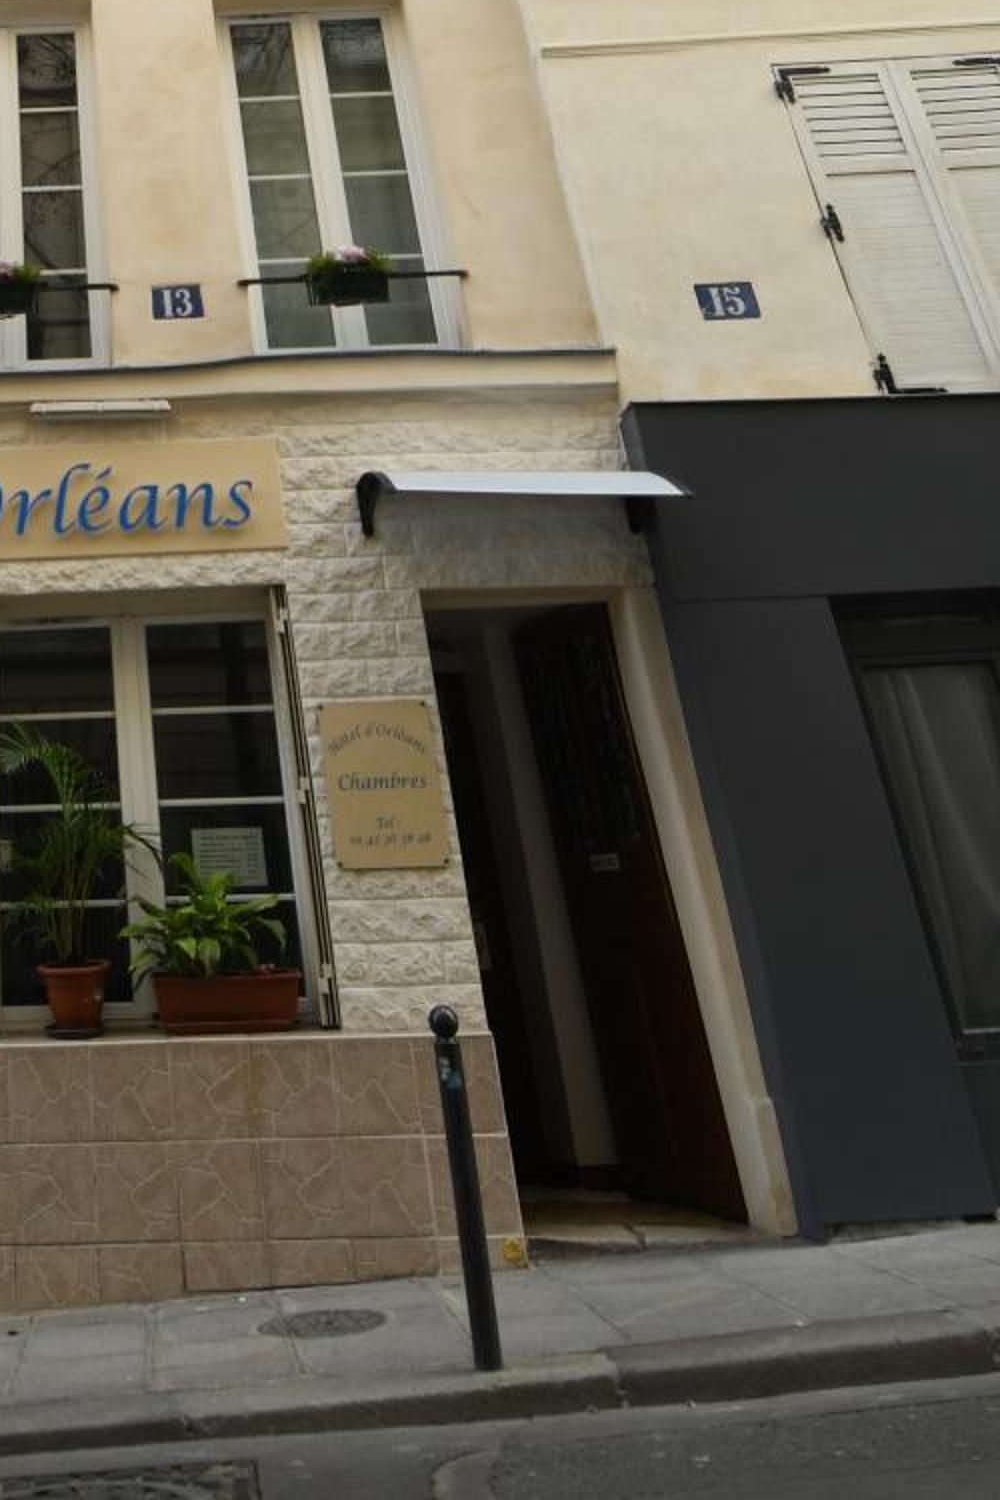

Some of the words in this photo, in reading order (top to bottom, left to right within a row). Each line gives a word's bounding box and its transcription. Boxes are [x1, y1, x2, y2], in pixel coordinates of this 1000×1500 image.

[162, 288, 193, 317] 13
[708, 286, 745, 316] 15
[338, 773, 427, 791] Chambres
